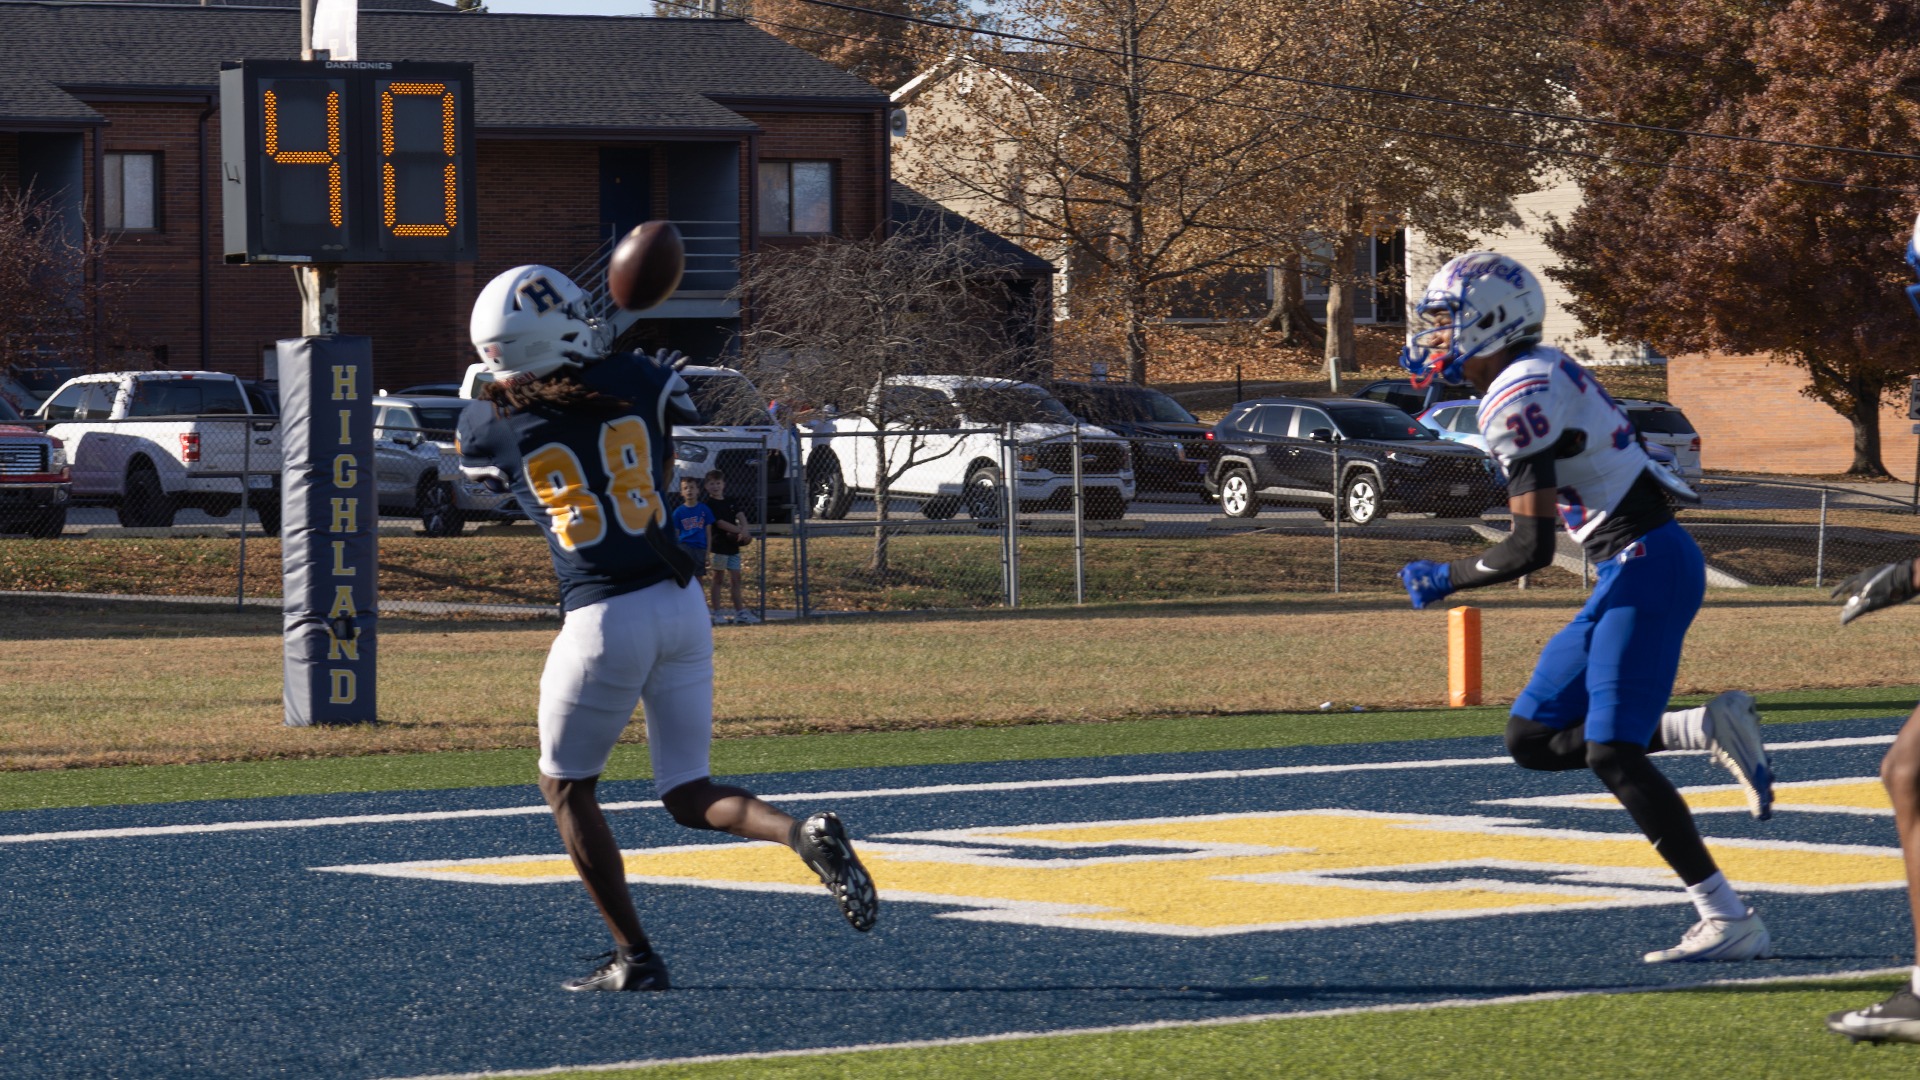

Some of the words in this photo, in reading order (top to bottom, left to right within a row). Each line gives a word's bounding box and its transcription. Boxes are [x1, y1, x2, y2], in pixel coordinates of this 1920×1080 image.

[325, 62, 393, 70] DAKTRONICS
[264, 82, 457, 237] 40
[518, 276, 564, 316] H
[1506, 402, 1550, 449] 36
[522, 415, 667, 551] 88
[327, 365, 359, 704] HIGHLAND
